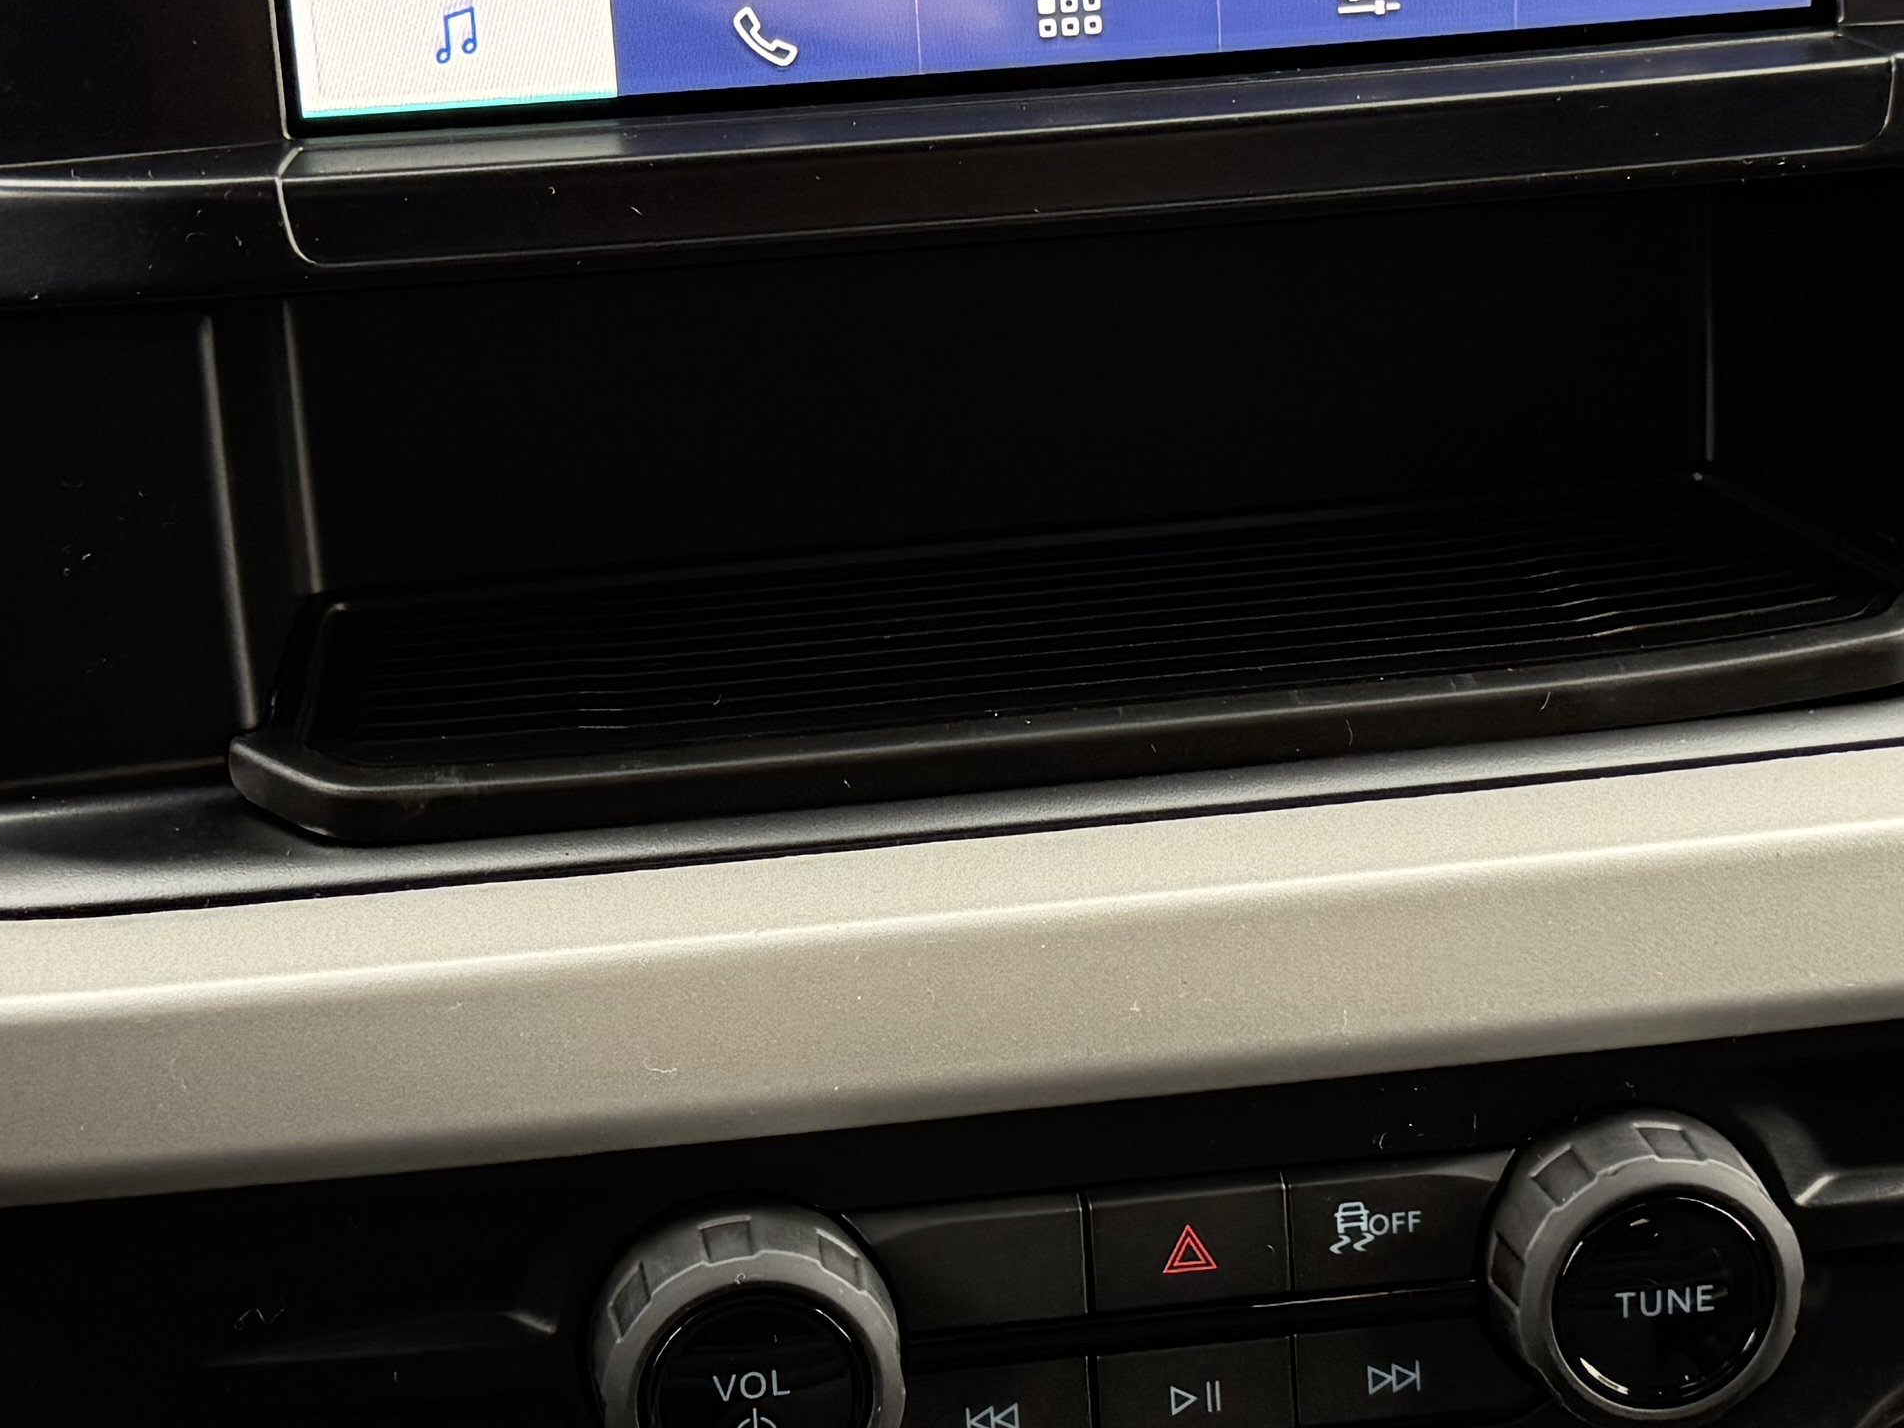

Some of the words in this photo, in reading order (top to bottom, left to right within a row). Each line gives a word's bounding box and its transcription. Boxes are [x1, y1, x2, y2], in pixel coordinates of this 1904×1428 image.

[1367, 1210, 1421, 1241] OFF
[1614, 1284, 1715, 1319] TUNE
[712, 1369, 791, 1402] VOL
